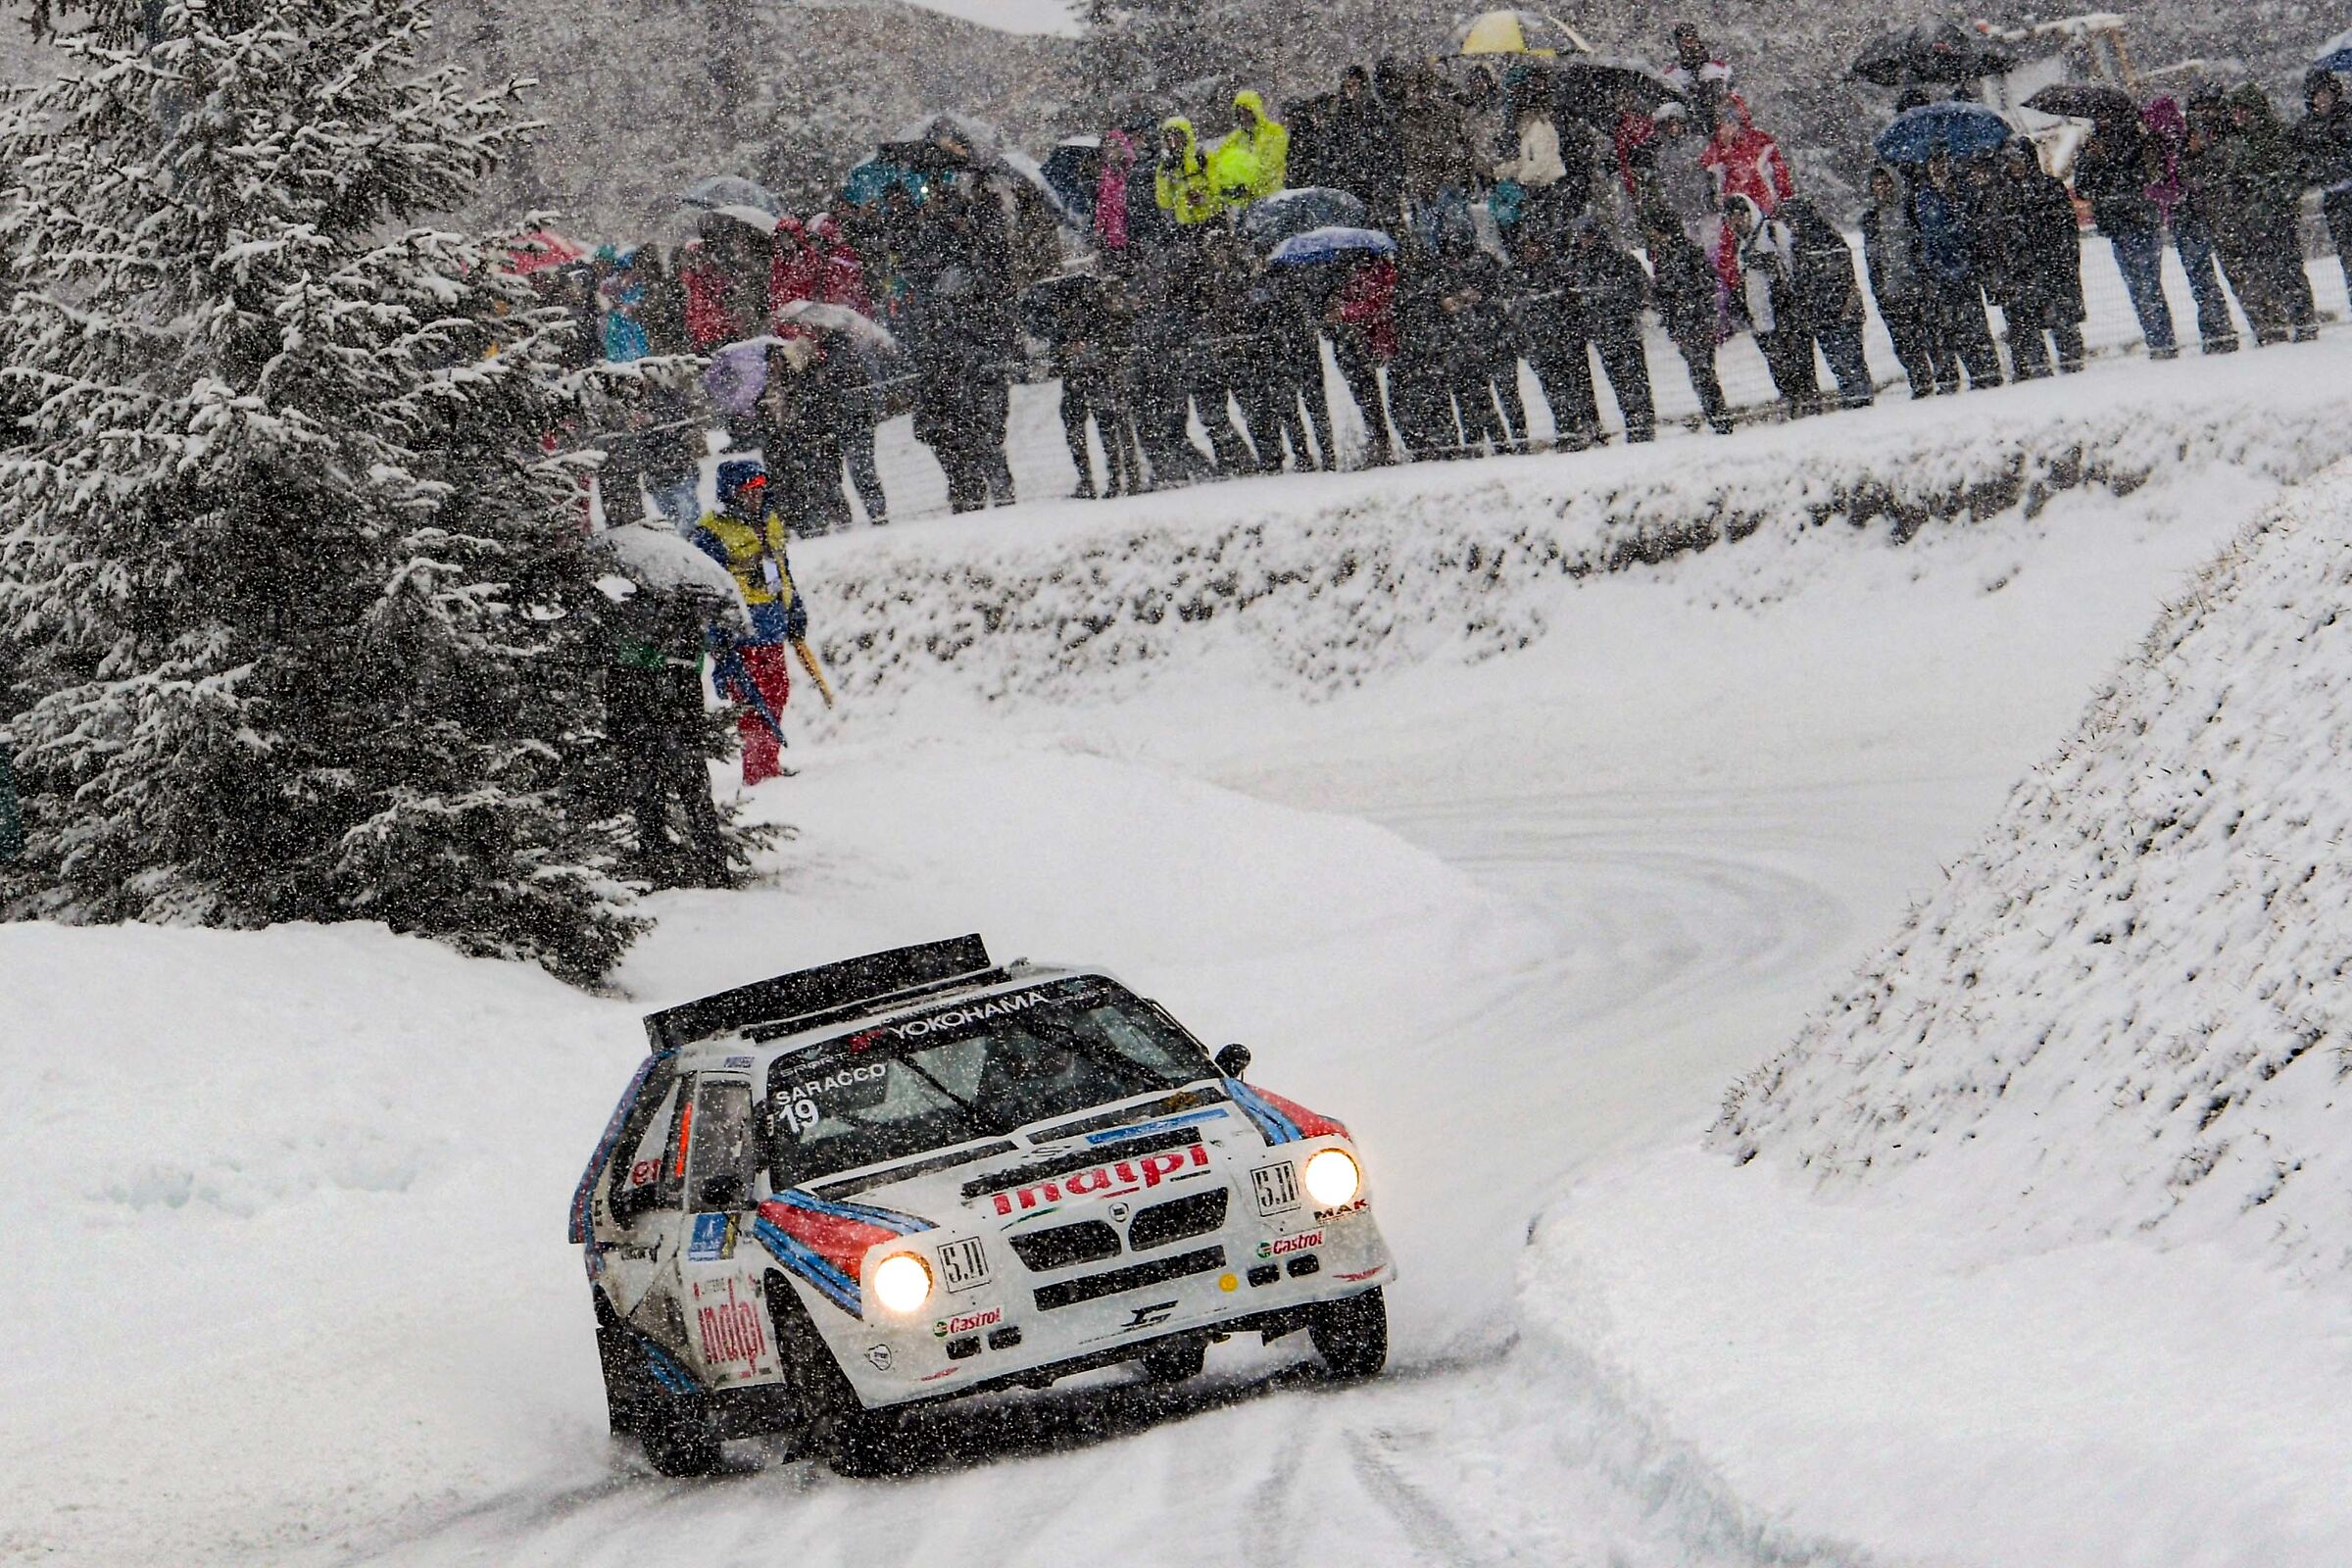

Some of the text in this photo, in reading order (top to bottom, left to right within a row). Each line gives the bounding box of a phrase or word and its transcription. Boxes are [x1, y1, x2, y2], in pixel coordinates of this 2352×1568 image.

[889, 992, 1050, 1040] YOKOHAMA
[776, 1062, 886, 1105] SARACCO
[779, 1099, 819, 1134] 19
[993, 1144, 1208, 1215] inalpi
[1273, 1231, 1322, 1254] Castrol
[950, 1307, 1001, 1334] Castrol
